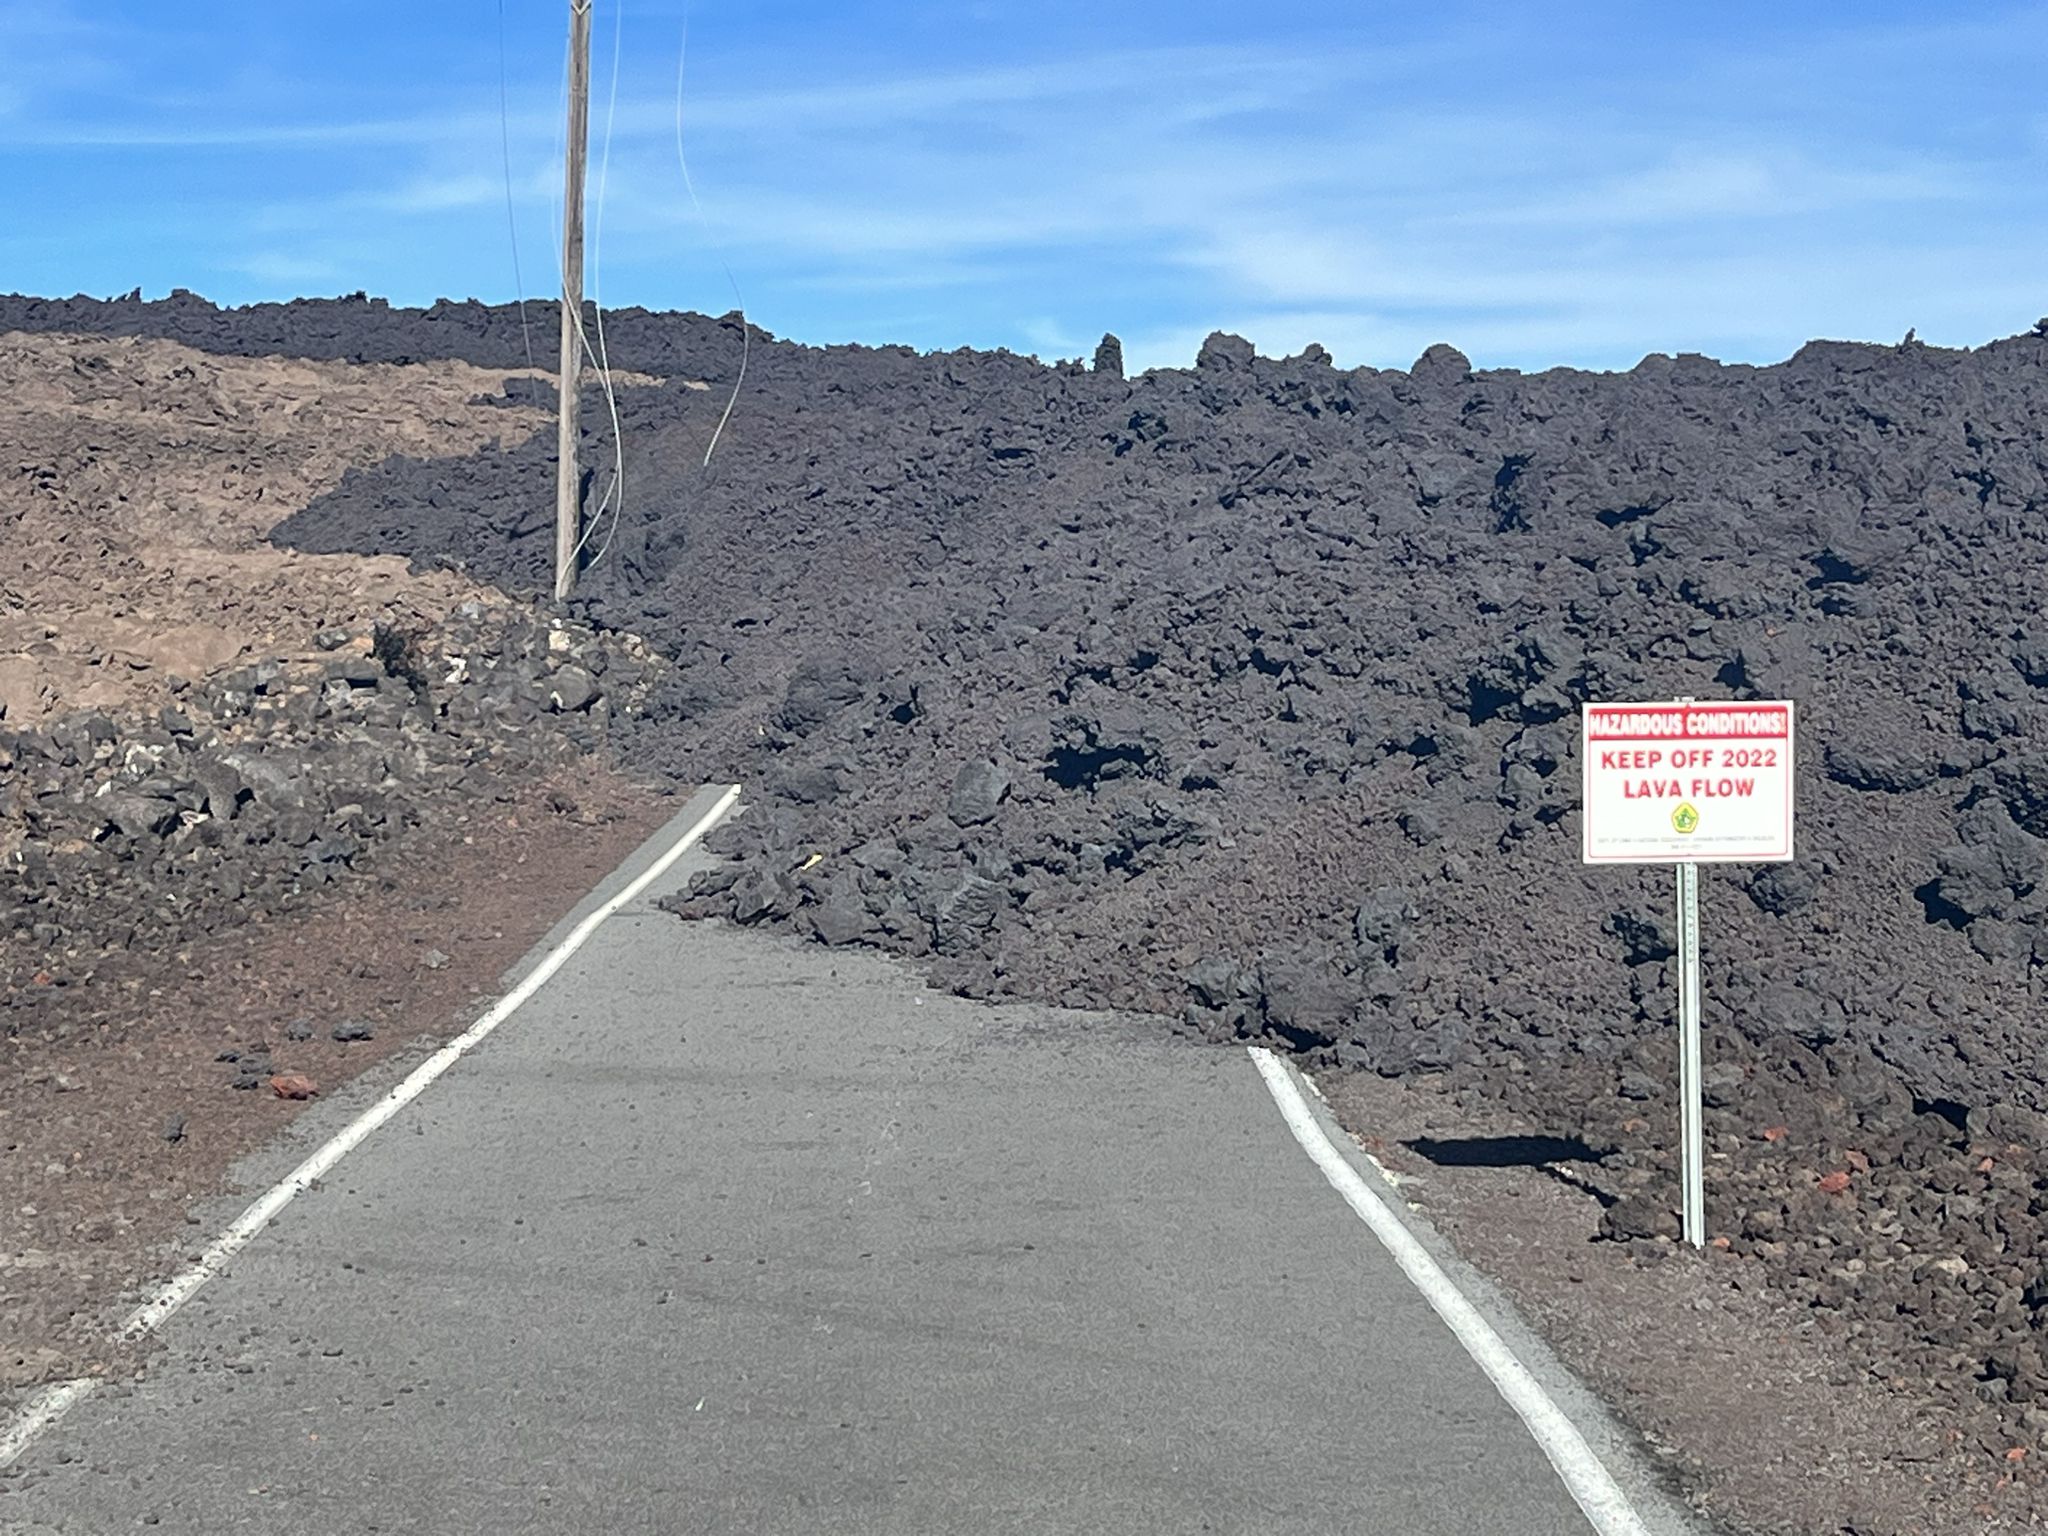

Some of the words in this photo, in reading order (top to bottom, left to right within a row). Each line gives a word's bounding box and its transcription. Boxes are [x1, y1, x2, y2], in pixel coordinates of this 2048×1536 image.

[1590, 713, 1683, 736] HAZARDOUS
[1601, 750, 1662, 769] KEEP
[1670, 749, 1714, 768] OFF
[1721, 748, 1777, 767] 2022
[1623, 779, 1683, 799] LAVA
[1691, 778, 1755, 798] FLOW
